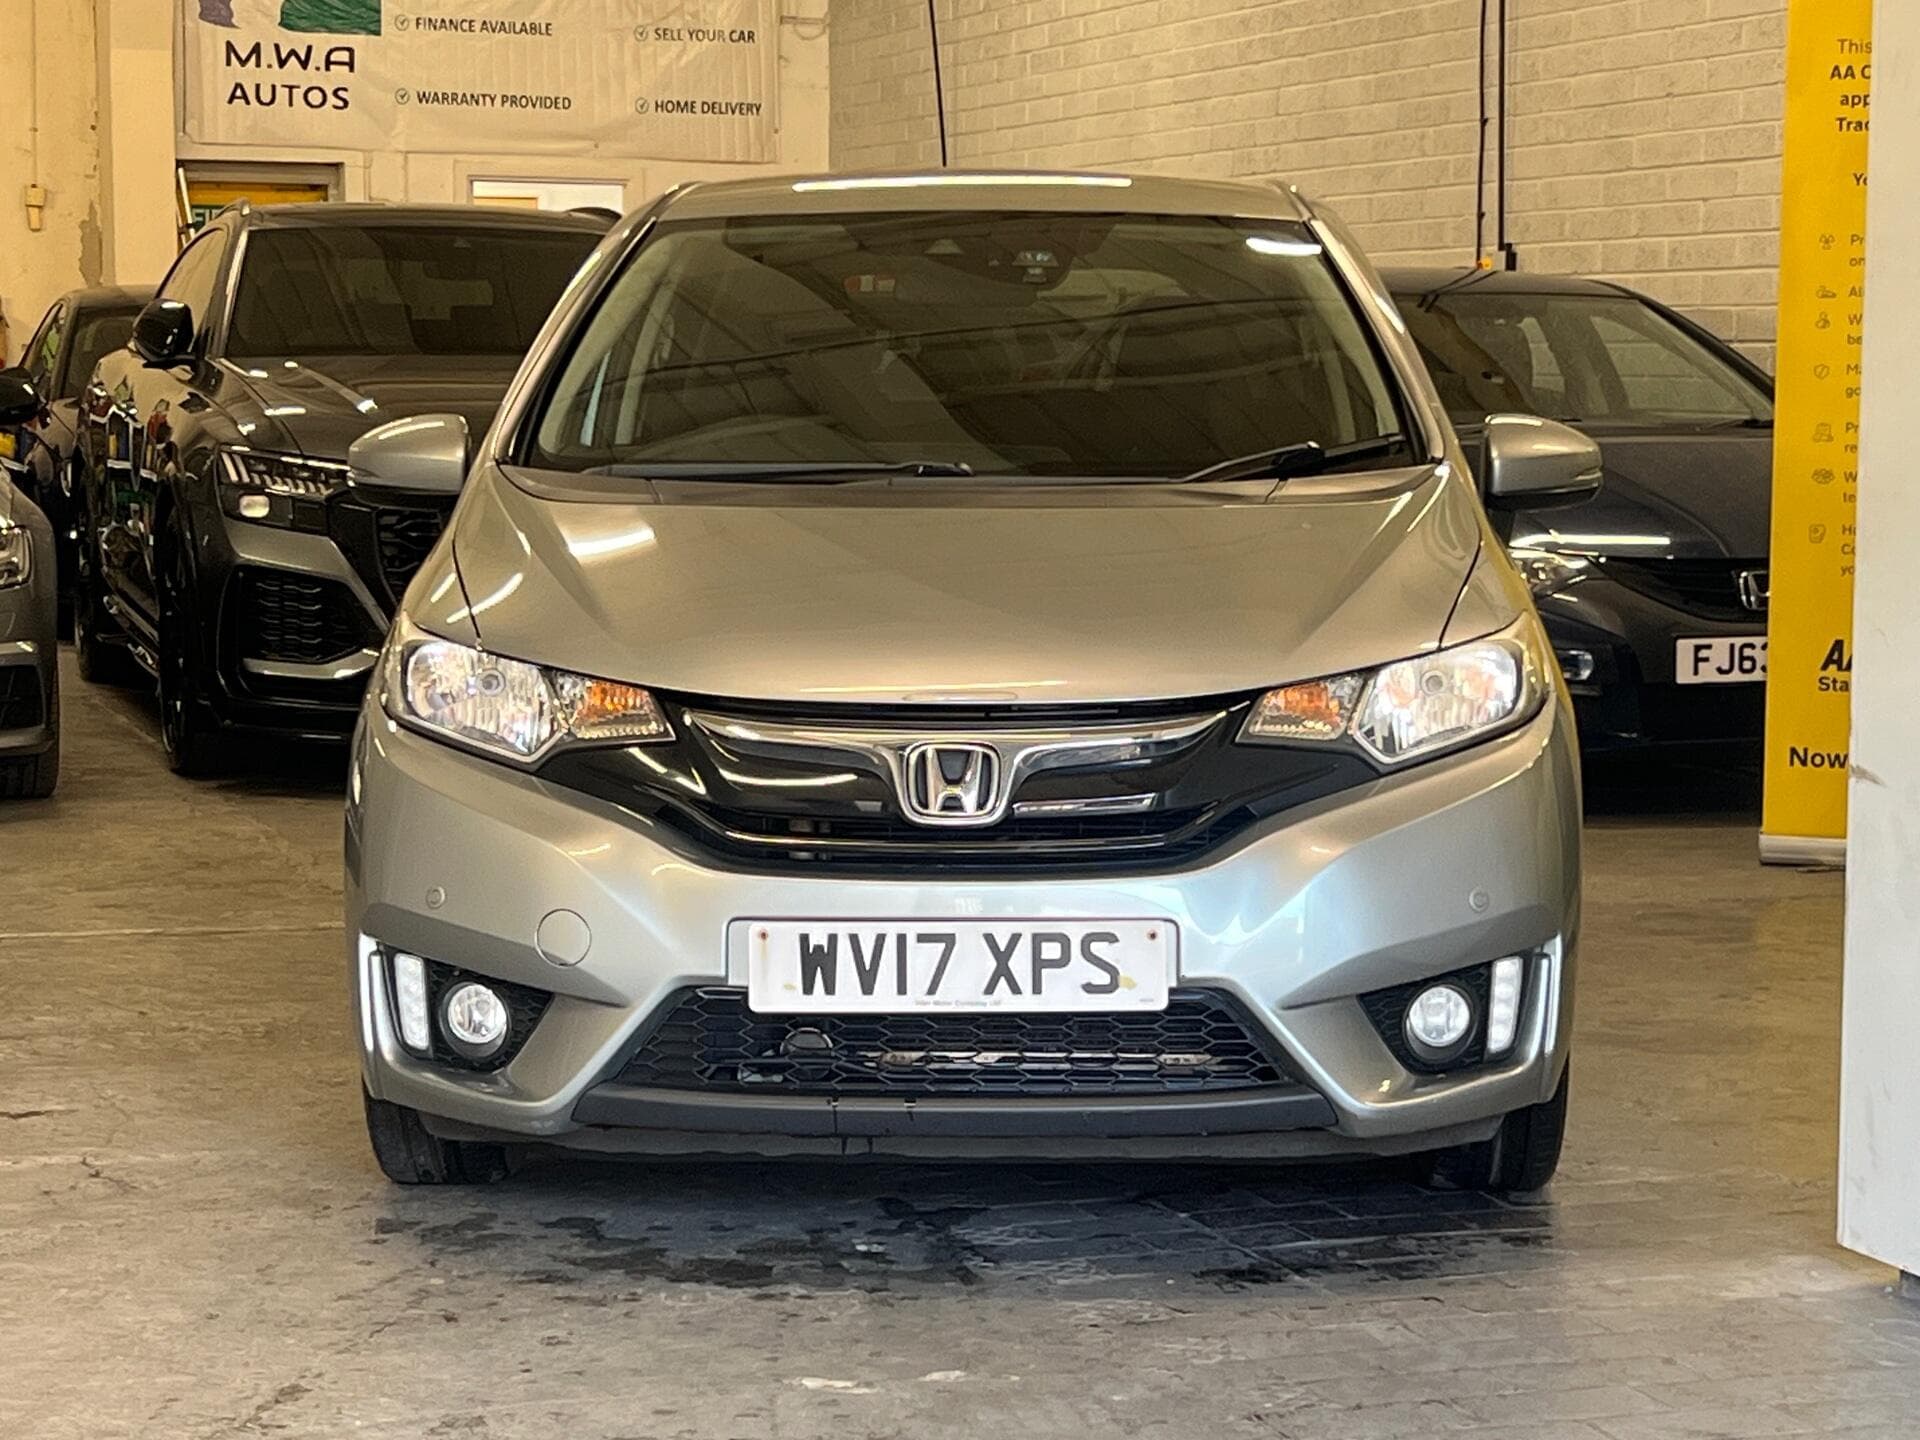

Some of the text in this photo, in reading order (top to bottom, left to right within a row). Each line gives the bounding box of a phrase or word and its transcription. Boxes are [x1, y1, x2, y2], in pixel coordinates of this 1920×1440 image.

[415, 16, 553, 37] FINANCE AVAILABLE
[654, 27, 756, 44] SELL YOUR CAR
[225, 39, 356, 73] M.W.A
[1837, 38, 1872, 54] This
[1830, 64, 1856, 80] AA
[226, 82, 350, 110] AUTOS
[416, 90, 572, 110] WARRANTY PROVIDED
[654, 99, 762, 116] HOME DELIVERY
[1820, 638, 1853, 672] A
[1818, 676, 1850, 693] Sta
[1789, 746, 1849, 769] Now
[799, 931, 1121, 996] WV17 XPS
